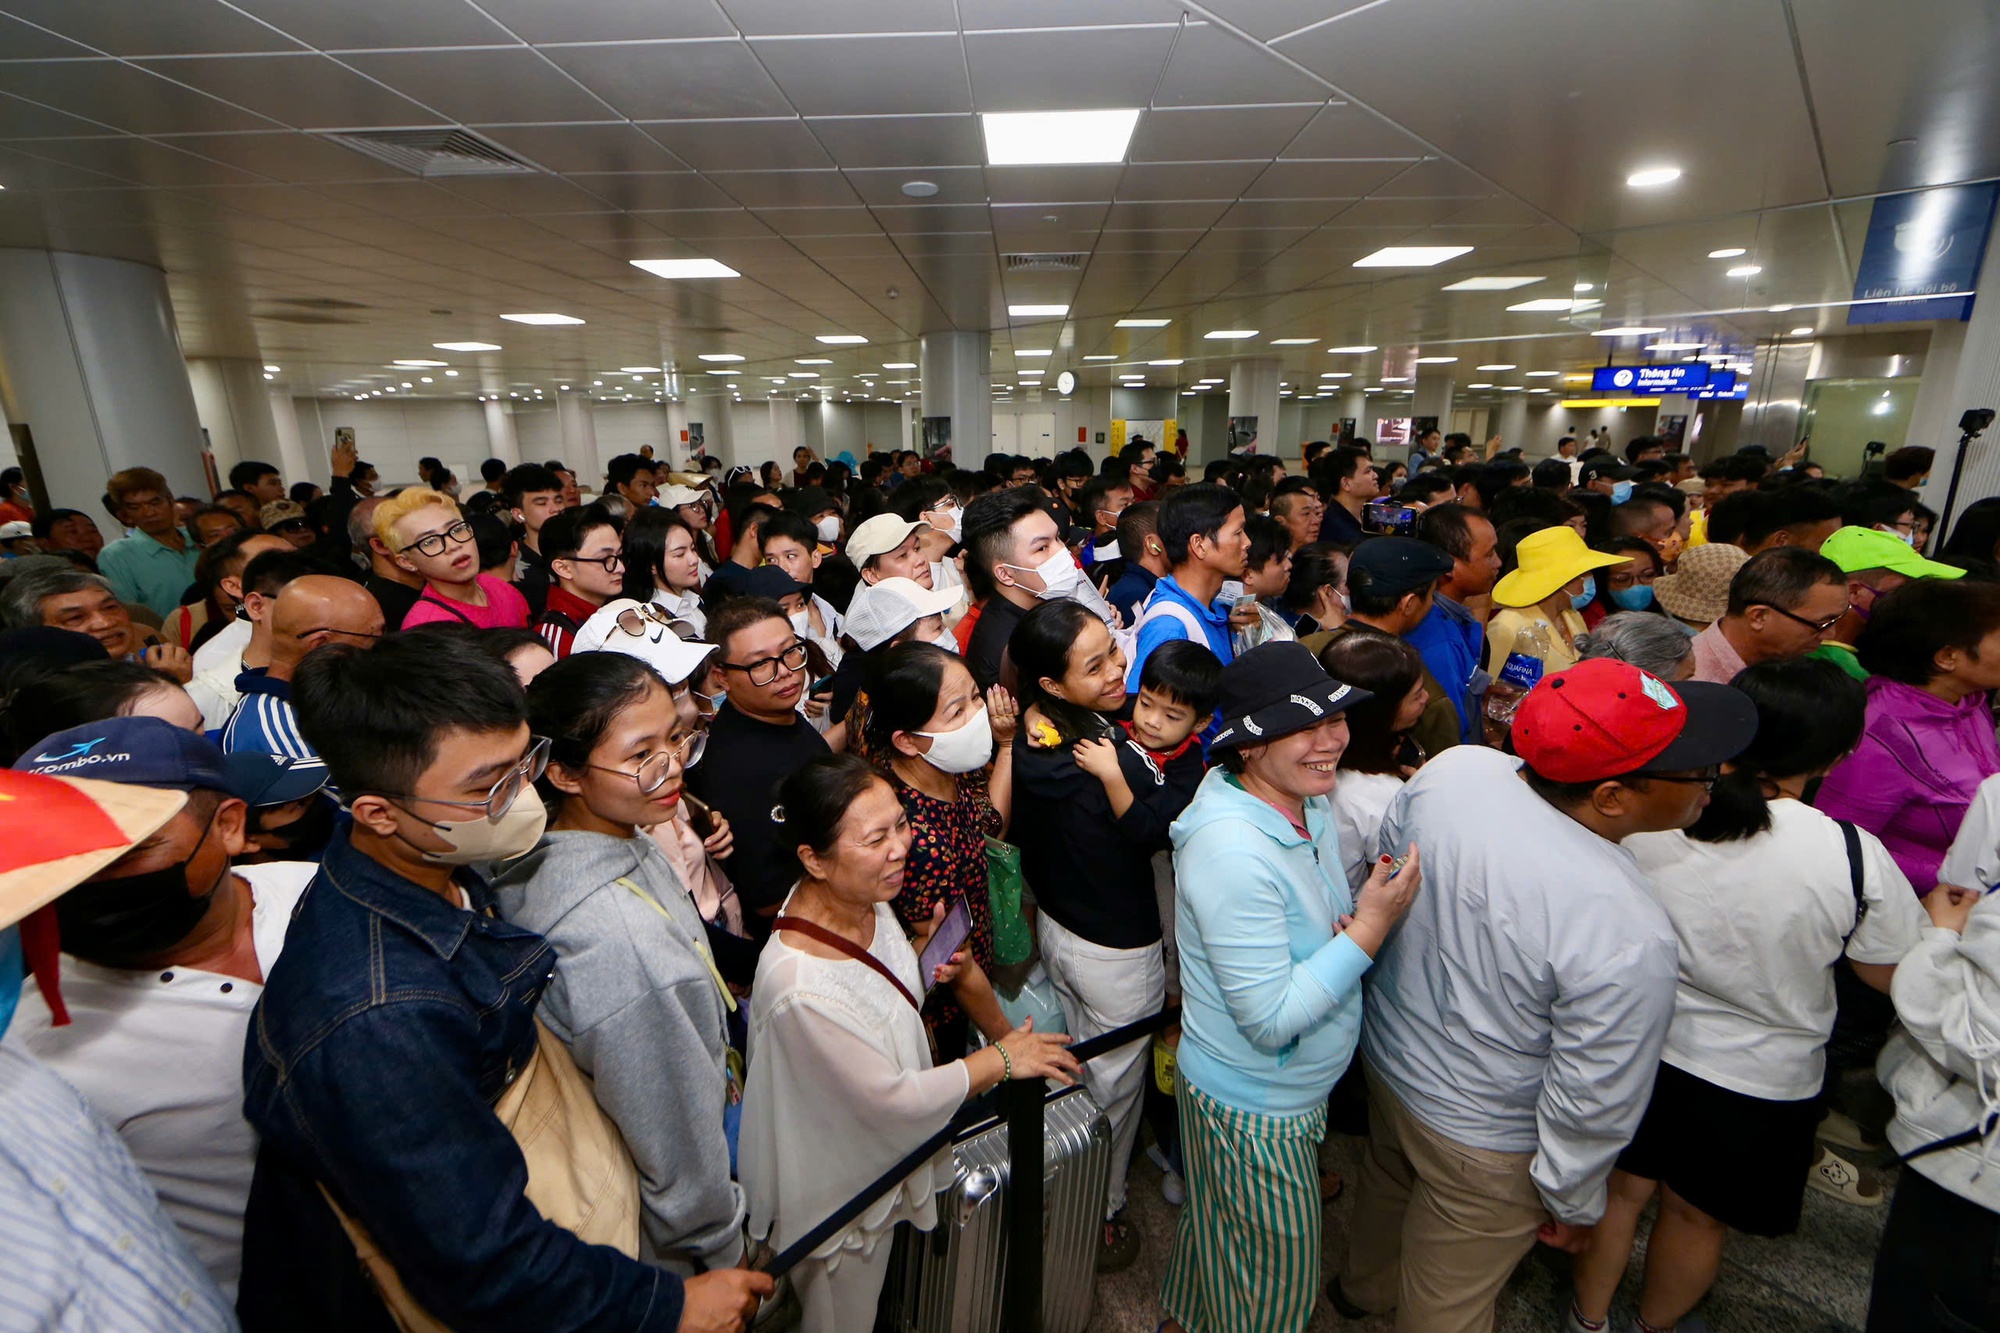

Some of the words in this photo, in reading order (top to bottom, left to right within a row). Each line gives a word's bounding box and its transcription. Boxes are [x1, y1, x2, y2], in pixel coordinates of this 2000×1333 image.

[1639, 368, 1671, 380] Thông
[1671, 367, 1686, 378] tin
[1637, 378, 1678, 387] Information
